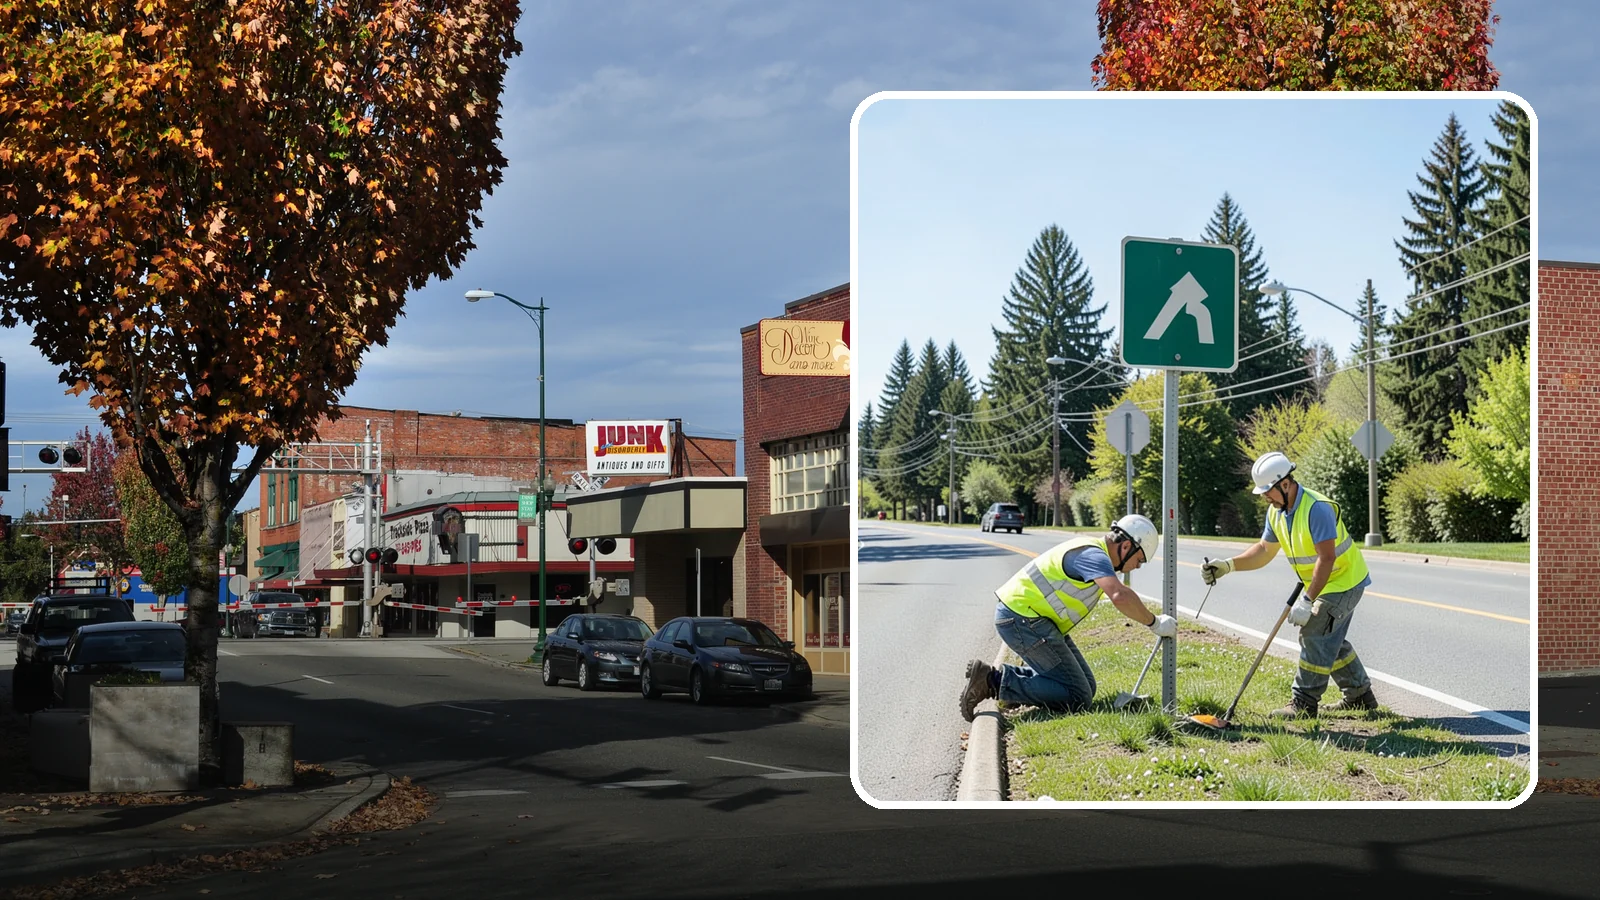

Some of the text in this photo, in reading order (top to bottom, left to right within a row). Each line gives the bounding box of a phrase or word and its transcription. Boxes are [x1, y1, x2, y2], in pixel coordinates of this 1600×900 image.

[765, 328, 831, 365] Decor
[595, 425, 665, 457] JUNK
[607, 446, 646, 454] DISORDERLY
[596, 460, 666, 470] ANTIQUES AND GIFTS
[390, 519, 429, 540] Trackside Pizza
